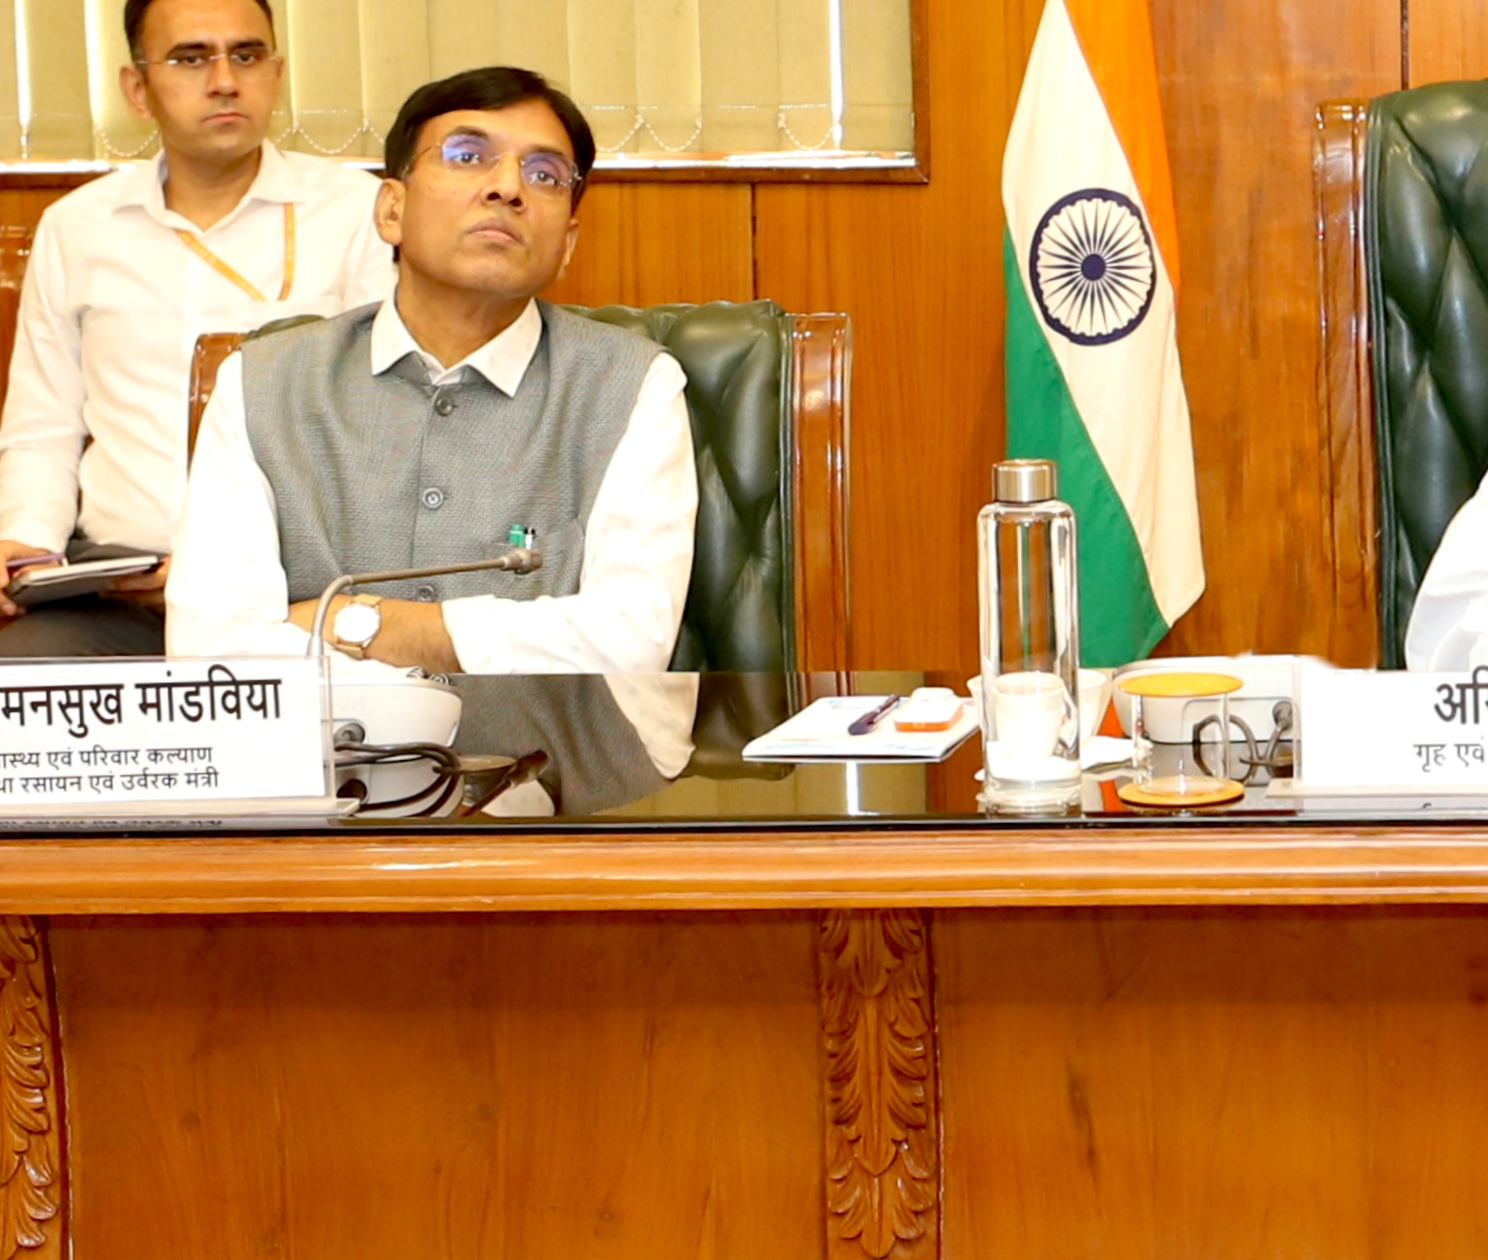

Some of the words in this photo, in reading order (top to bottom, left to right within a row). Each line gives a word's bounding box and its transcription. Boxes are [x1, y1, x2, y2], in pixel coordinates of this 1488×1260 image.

[0, 683, 125, 738] मनसुख
[135, 663, 283, 723] मांडविया
[46, 747, 73, 770] एवं
[78, 744, 140, 767] परिवार
[146, 747, 213, 764] कल्याण
[1413, 743, 1446, 772] गृह
[1454, 736, 1485, 767] एवं
[20, 775, 82, 793] रसायन
[88, 771, 115, 793] एवं
[120, 767, 178, 790] उर्वरक
[184, 766, 220, 788] मंत्री
